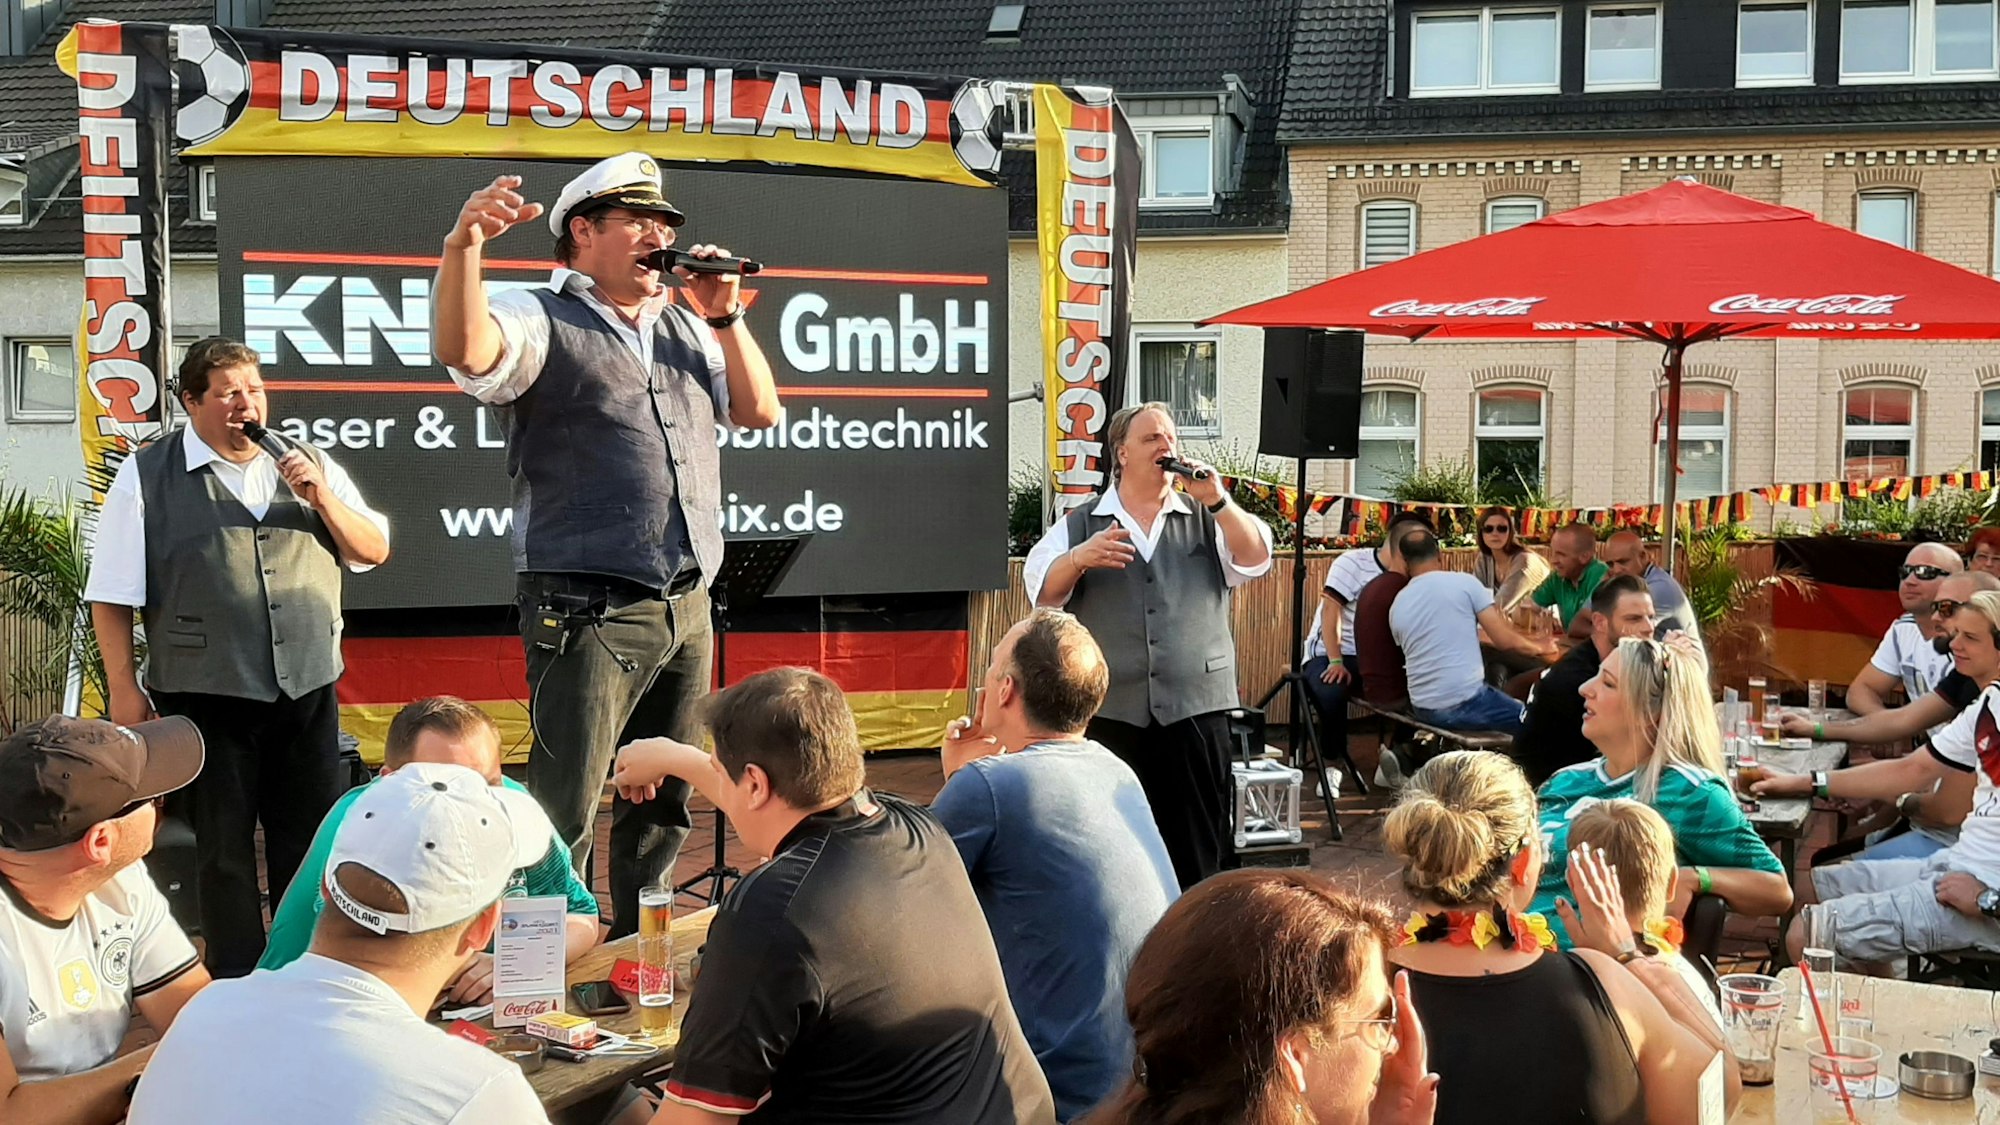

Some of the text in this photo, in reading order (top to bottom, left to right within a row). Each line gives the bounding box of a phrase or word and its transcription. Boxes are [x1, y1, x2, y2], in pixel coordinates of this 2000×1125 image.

[279, 51, 927, 148] DEUTSCHLAND
[1709, 294, 1906, 315] Coca-Cola
[780, 293, 989, 373] GmbH
[279, 406, 989, 450] aser & L bildtechnik
[440, 490, 844, 537] ww ix.de
[504, 1000, 548, 1017] Coca-Cola
